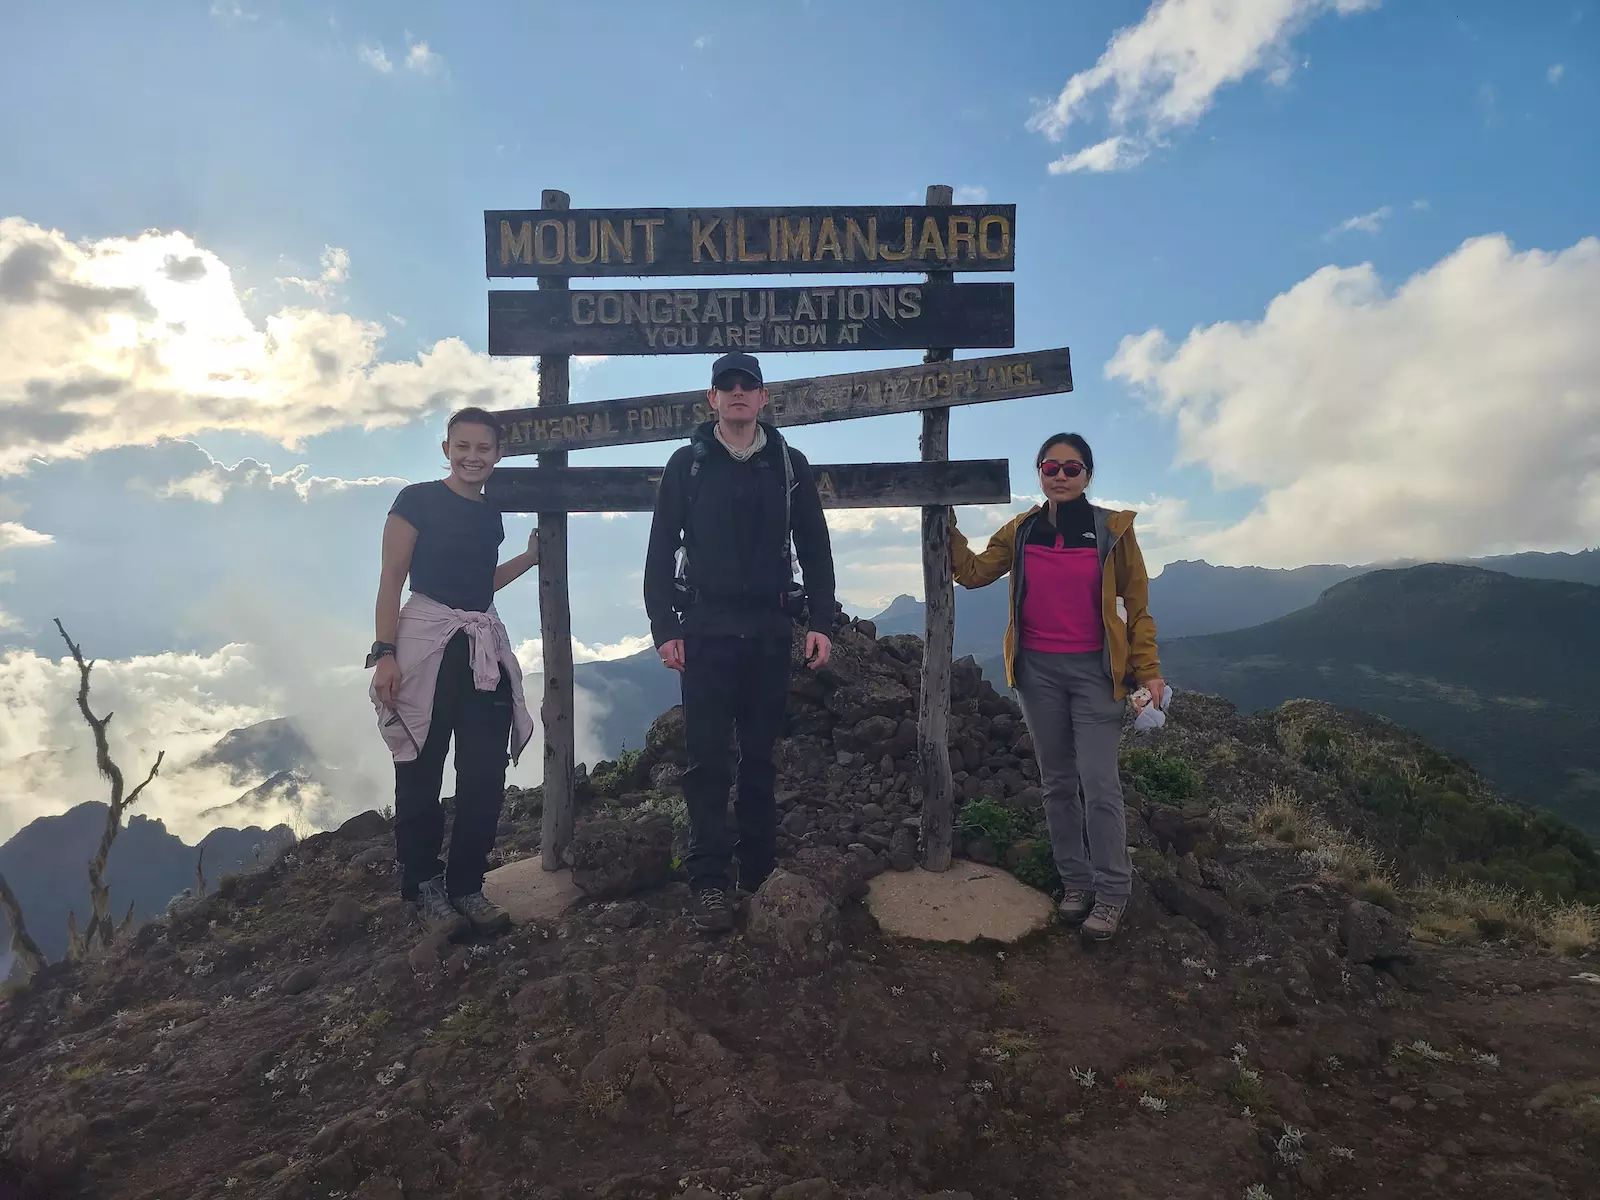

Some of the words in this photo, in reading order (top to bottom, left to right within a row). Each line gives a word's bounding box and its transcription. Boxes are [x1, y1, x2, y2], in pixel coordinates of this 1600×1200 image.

[500, 218, 665, 265] MOUNT
[692, 215, 1011, 262] KILIMANJARO
[571, 286, 922, 325] CONGRATULATIONS
[646, 326, 699, 348] YOU
[707, 326, 762, 347] ARE
[774, 324, 828, 346] NOW
[837, 323, 863, 344] AT
